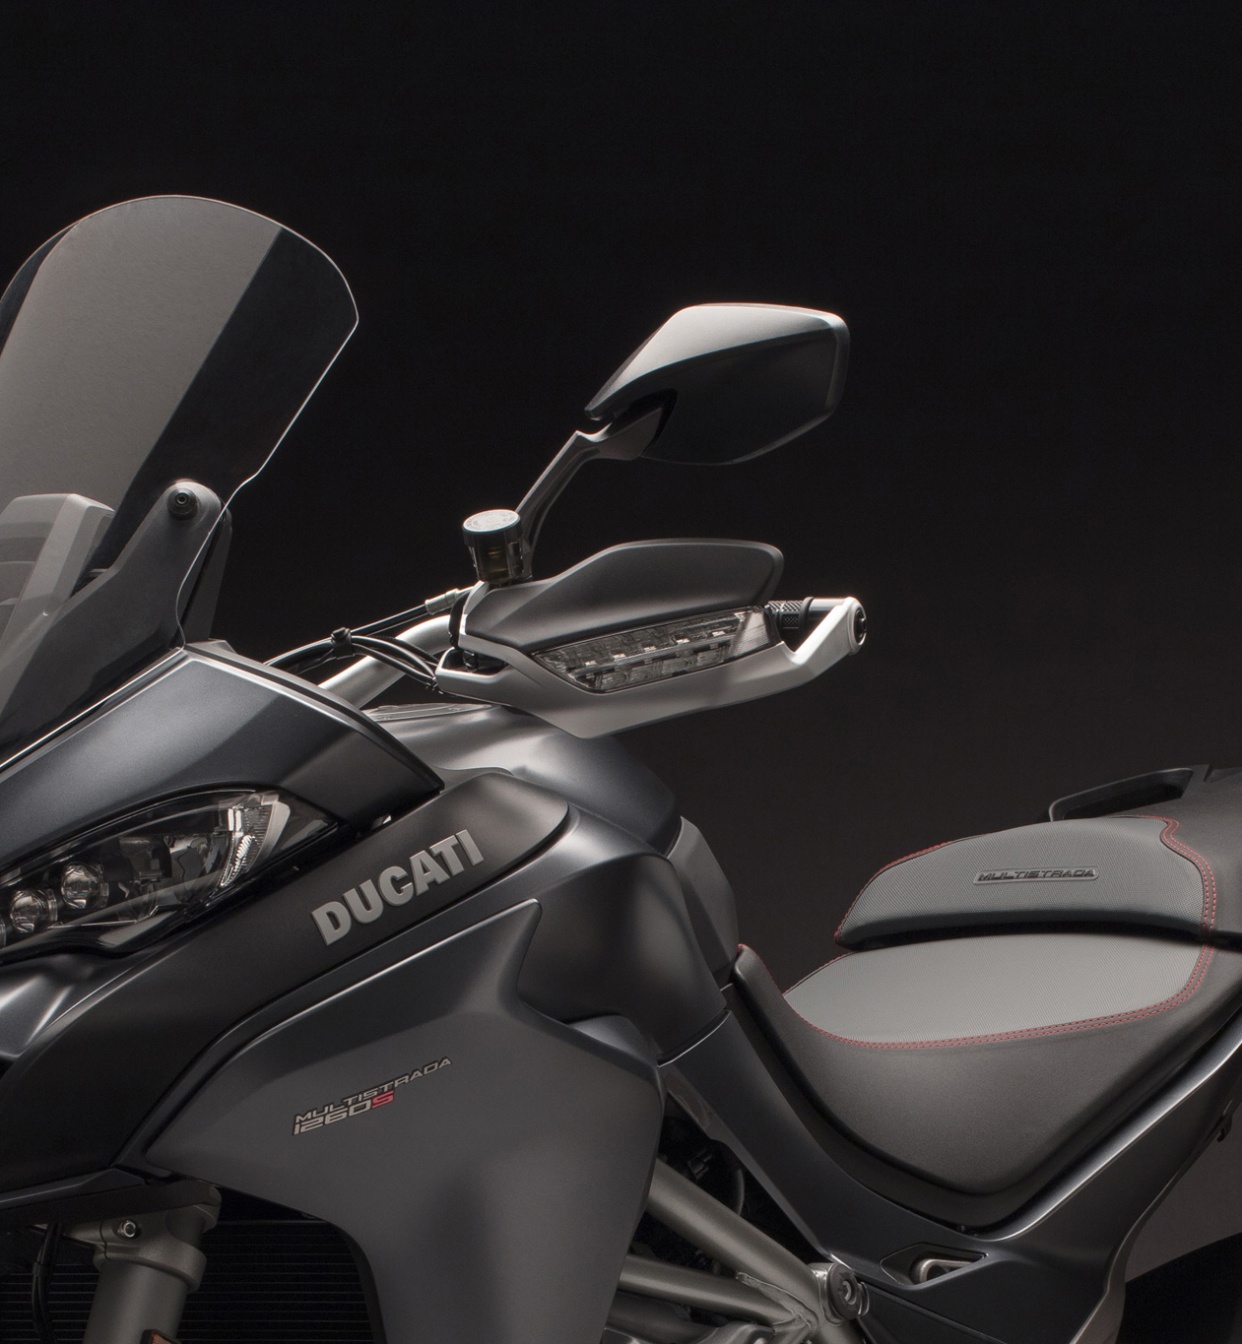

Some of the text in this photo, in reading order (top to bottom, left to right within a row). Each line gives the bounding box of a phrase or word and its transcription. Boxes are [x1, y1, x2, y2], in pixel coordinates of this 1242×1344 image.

[311, 829, 484, 946] DUCATI
[977, 869, 1095, 881] MULTISTRADA
[293, 1089, 395, 1135] 1260S
[295, 1057, 452, 1123] MULTISTRADA
